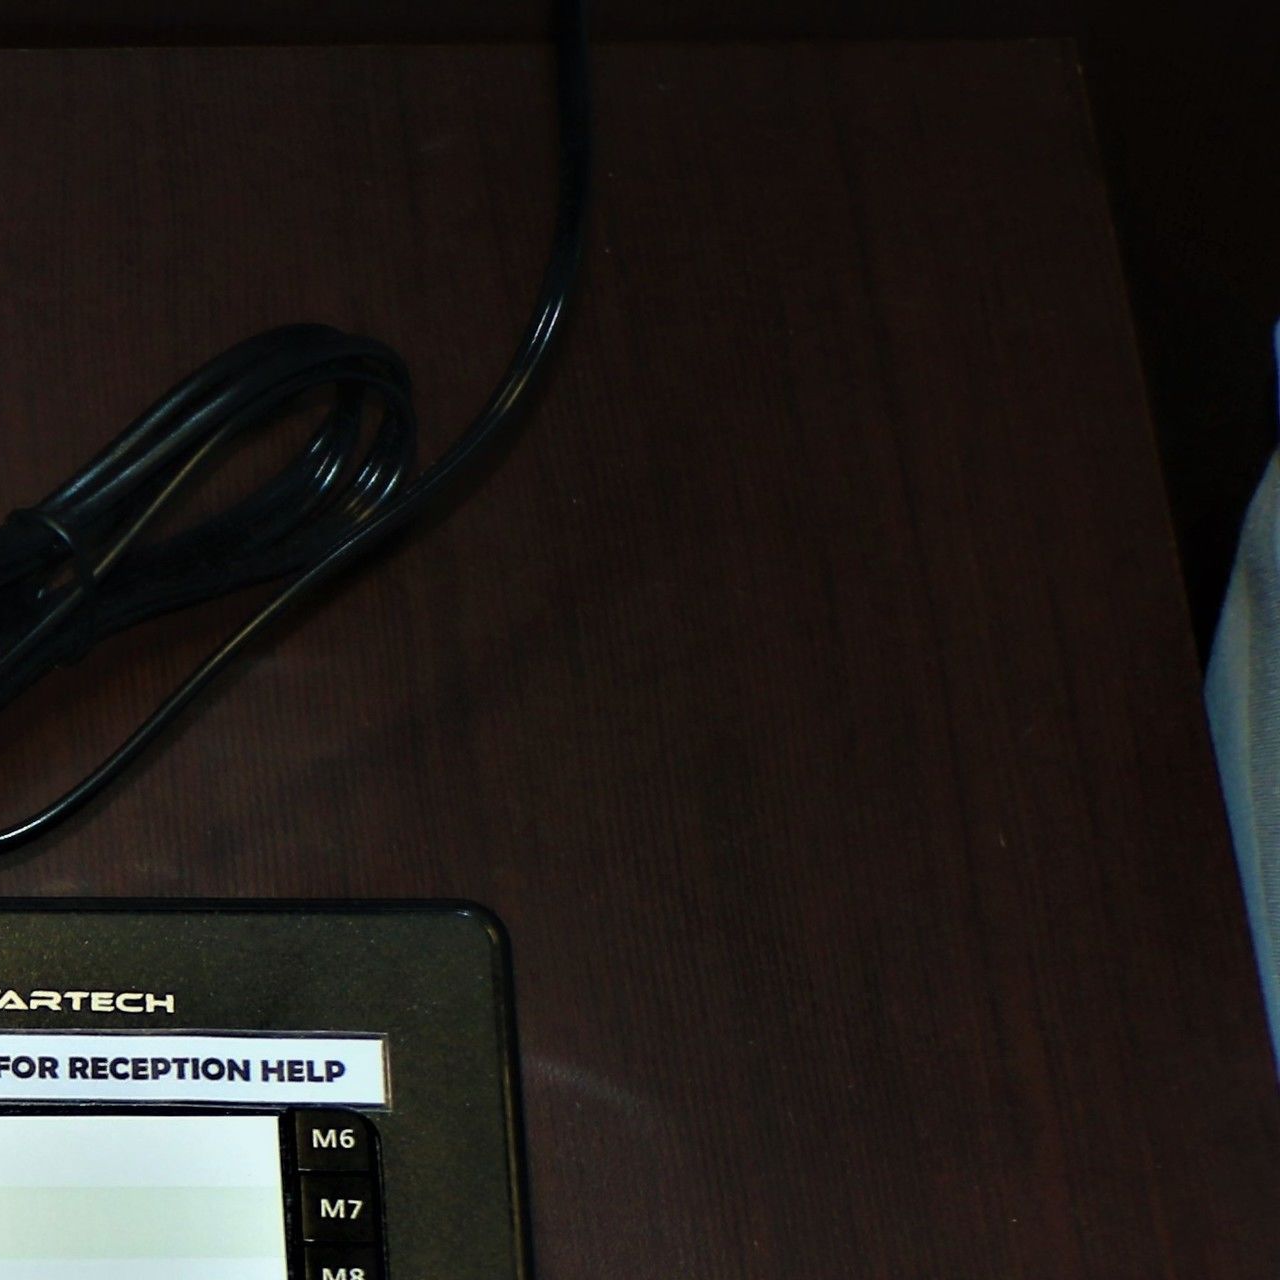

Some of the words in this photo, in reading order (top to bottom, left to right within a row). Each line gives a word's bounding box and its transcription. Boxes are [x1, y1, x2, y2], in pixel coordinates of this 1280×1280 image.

[69, 1056, 251, 1082] RECEPTION
[260, 1059, 346, 1083] HELP
[312, 1128, 355, 1149] M6
[320, 1198, 363, 1220] M7
